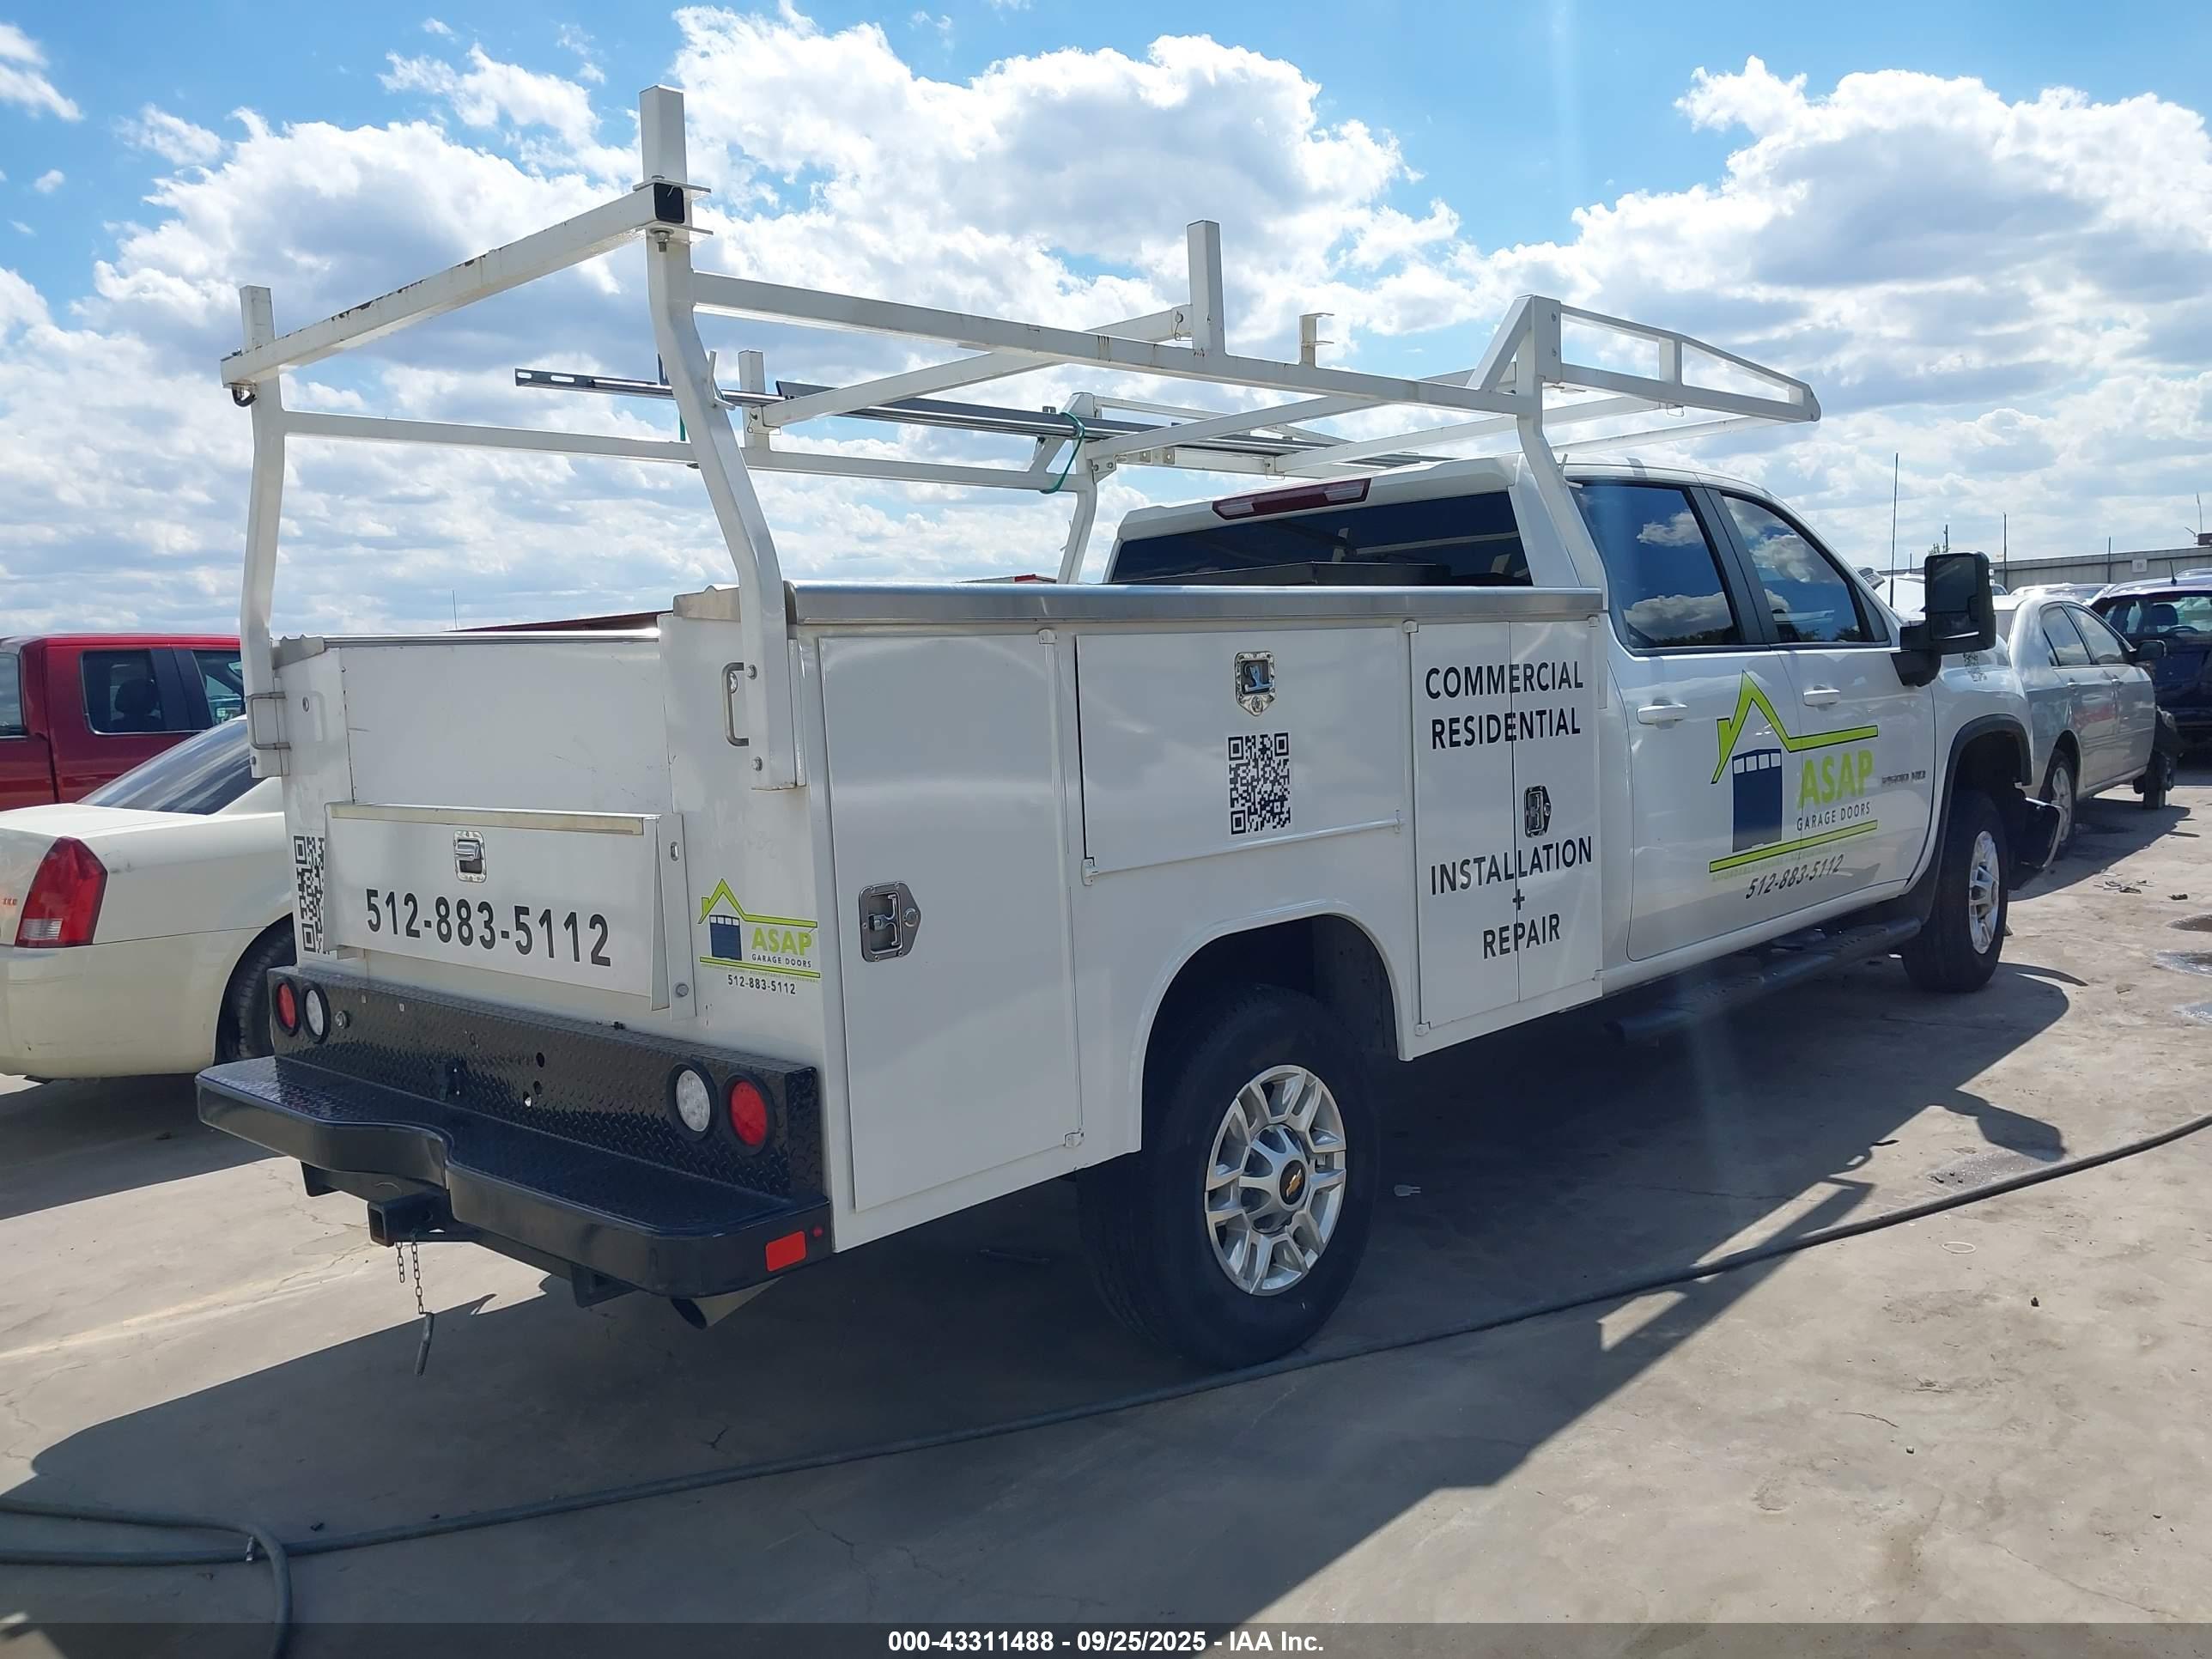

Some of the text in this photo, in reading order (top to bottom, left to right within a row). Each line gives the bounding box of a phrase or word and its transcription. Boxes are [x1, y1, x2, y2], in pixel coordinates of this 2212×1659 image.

[1425, 660, 1584, 700] COMMERCIAL
[1431, 707, 1581, 750] RESIDENTIAL
[1797, 749, 1874, 810] ASAP
[1796, 801, 1870, 831] GARAGE DOORS
[1431, 836, 1592, 896] INSTALLATION
[1745, 854, 1844, 900] 512-883-5112
[1512, 888, 1526, 911] +
[366, 888, 611, 967] 512-883-5112
[751, 927, 812, 956] ASAP
[1483, 913, 1560, 960] REPAIR
[751, 953, 811, 968] GARAGE DOORS
[727, 974, 796, 994] 512-883-5112
